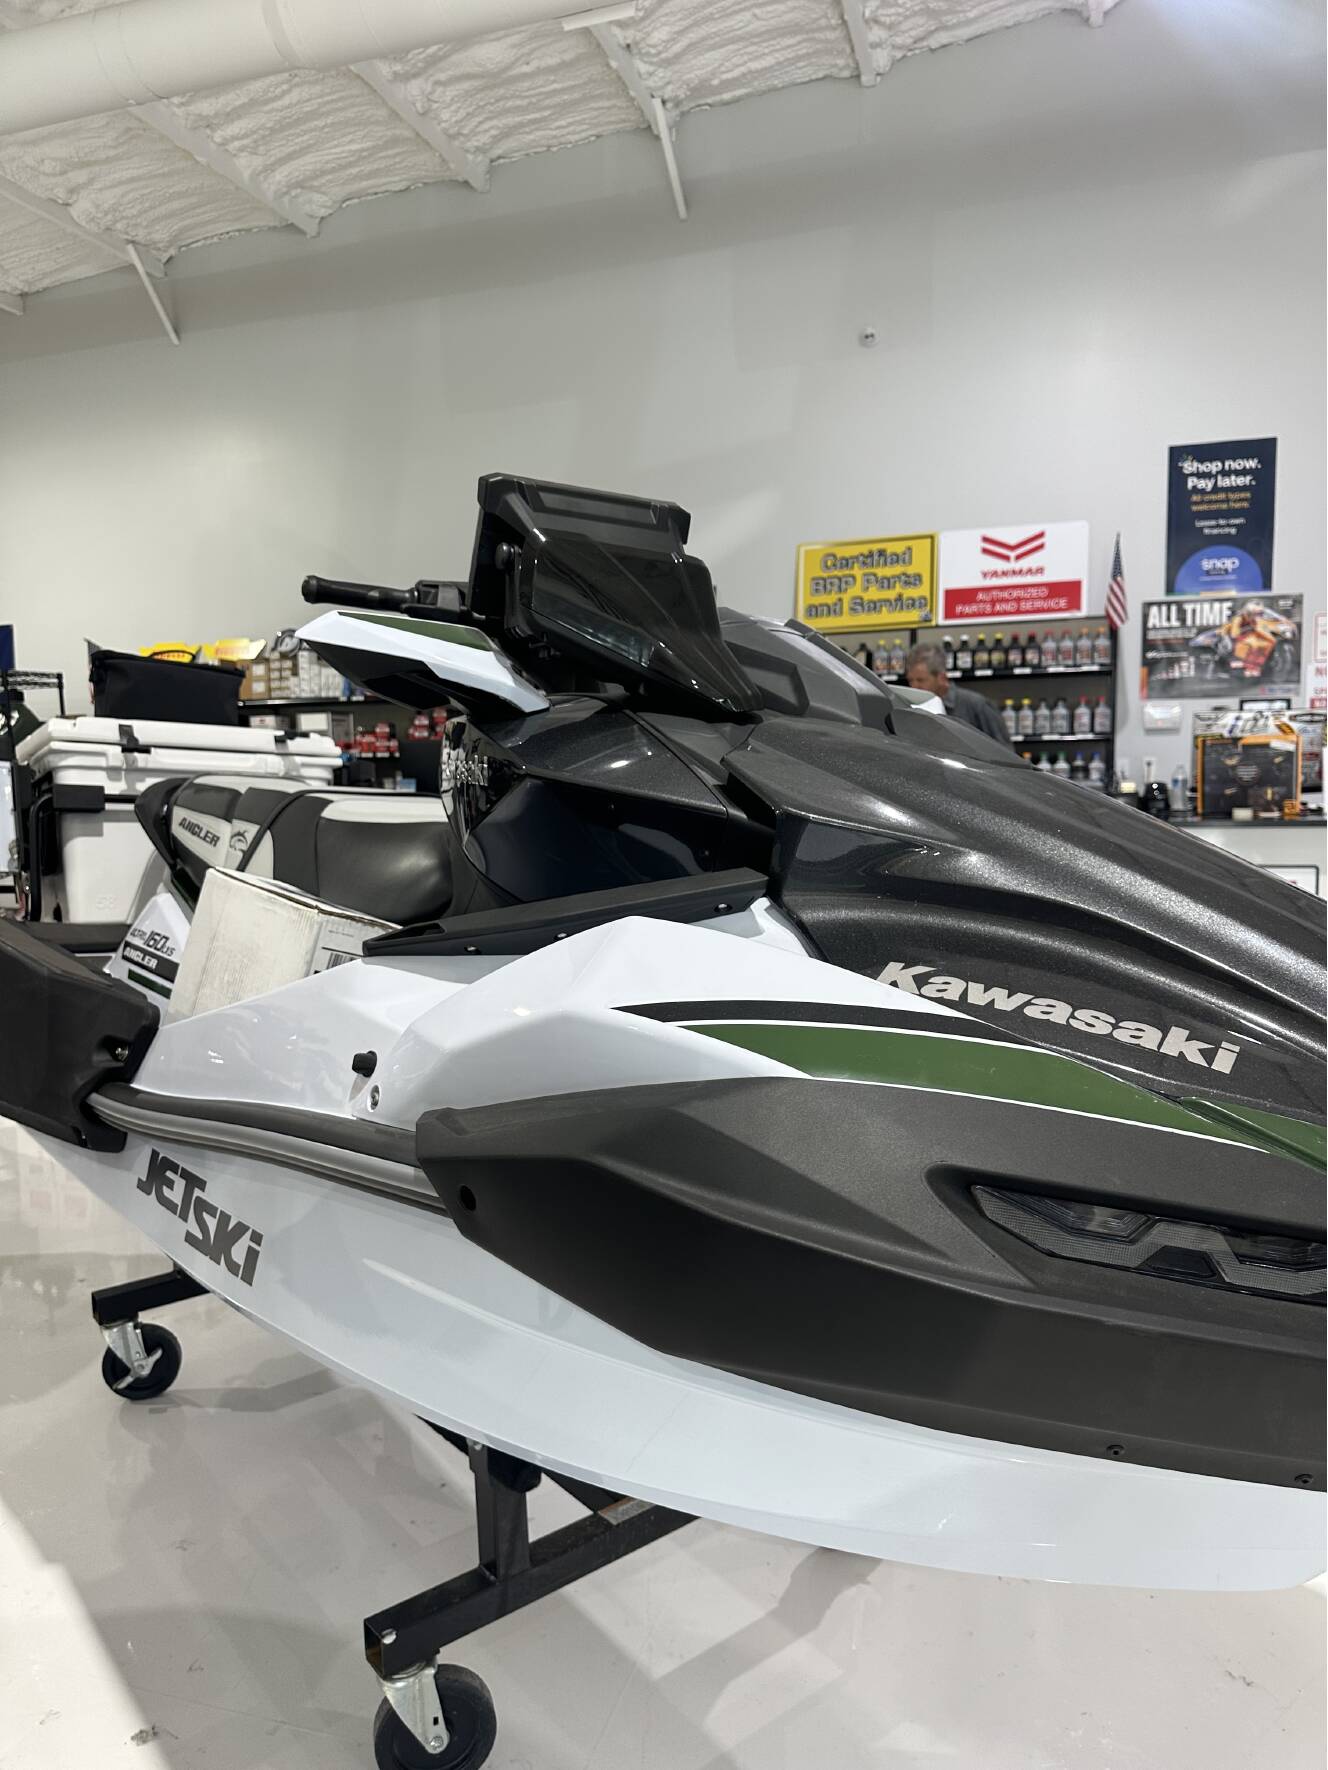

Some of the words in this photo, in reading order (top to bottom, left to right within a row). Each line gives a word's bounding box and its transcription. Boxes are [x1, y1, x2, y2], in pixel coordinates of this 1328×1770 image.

[1182, 459, 1222, 475] Shop
[1224, 457, 1262, 471] now.
[1187, 475, 1216, 492] Pay
[1217, 473, 1256, 488] later.
[821, 546, 913, 572] Certified
[1201, 556, 1240, 572] snap
[810, 573, 856, 597] BRP
[861, 572, 923, 592] Parts
[981, 566, 1045, 580] YANMAR
[976, 585, 1049, 602] AUTHORIZED
[805, 597, 844, 620] and
[848, 592, 928, 616] Service
[955, 602, 992, 615] PARTS
[994, 601, 1018, 613] AND
[1020, 597, 1069, 610] SERVICE
[1147, 603, 1181, 628] ALL
[1182, 600, 1234, 627] TIME
[178, 816, 221, 848] ANGLER
[123, 946, 159, 970] ANGLER
[875, 961, 1241, 1075] Kawasaki
[136, 1147, 208, 1224] JET
